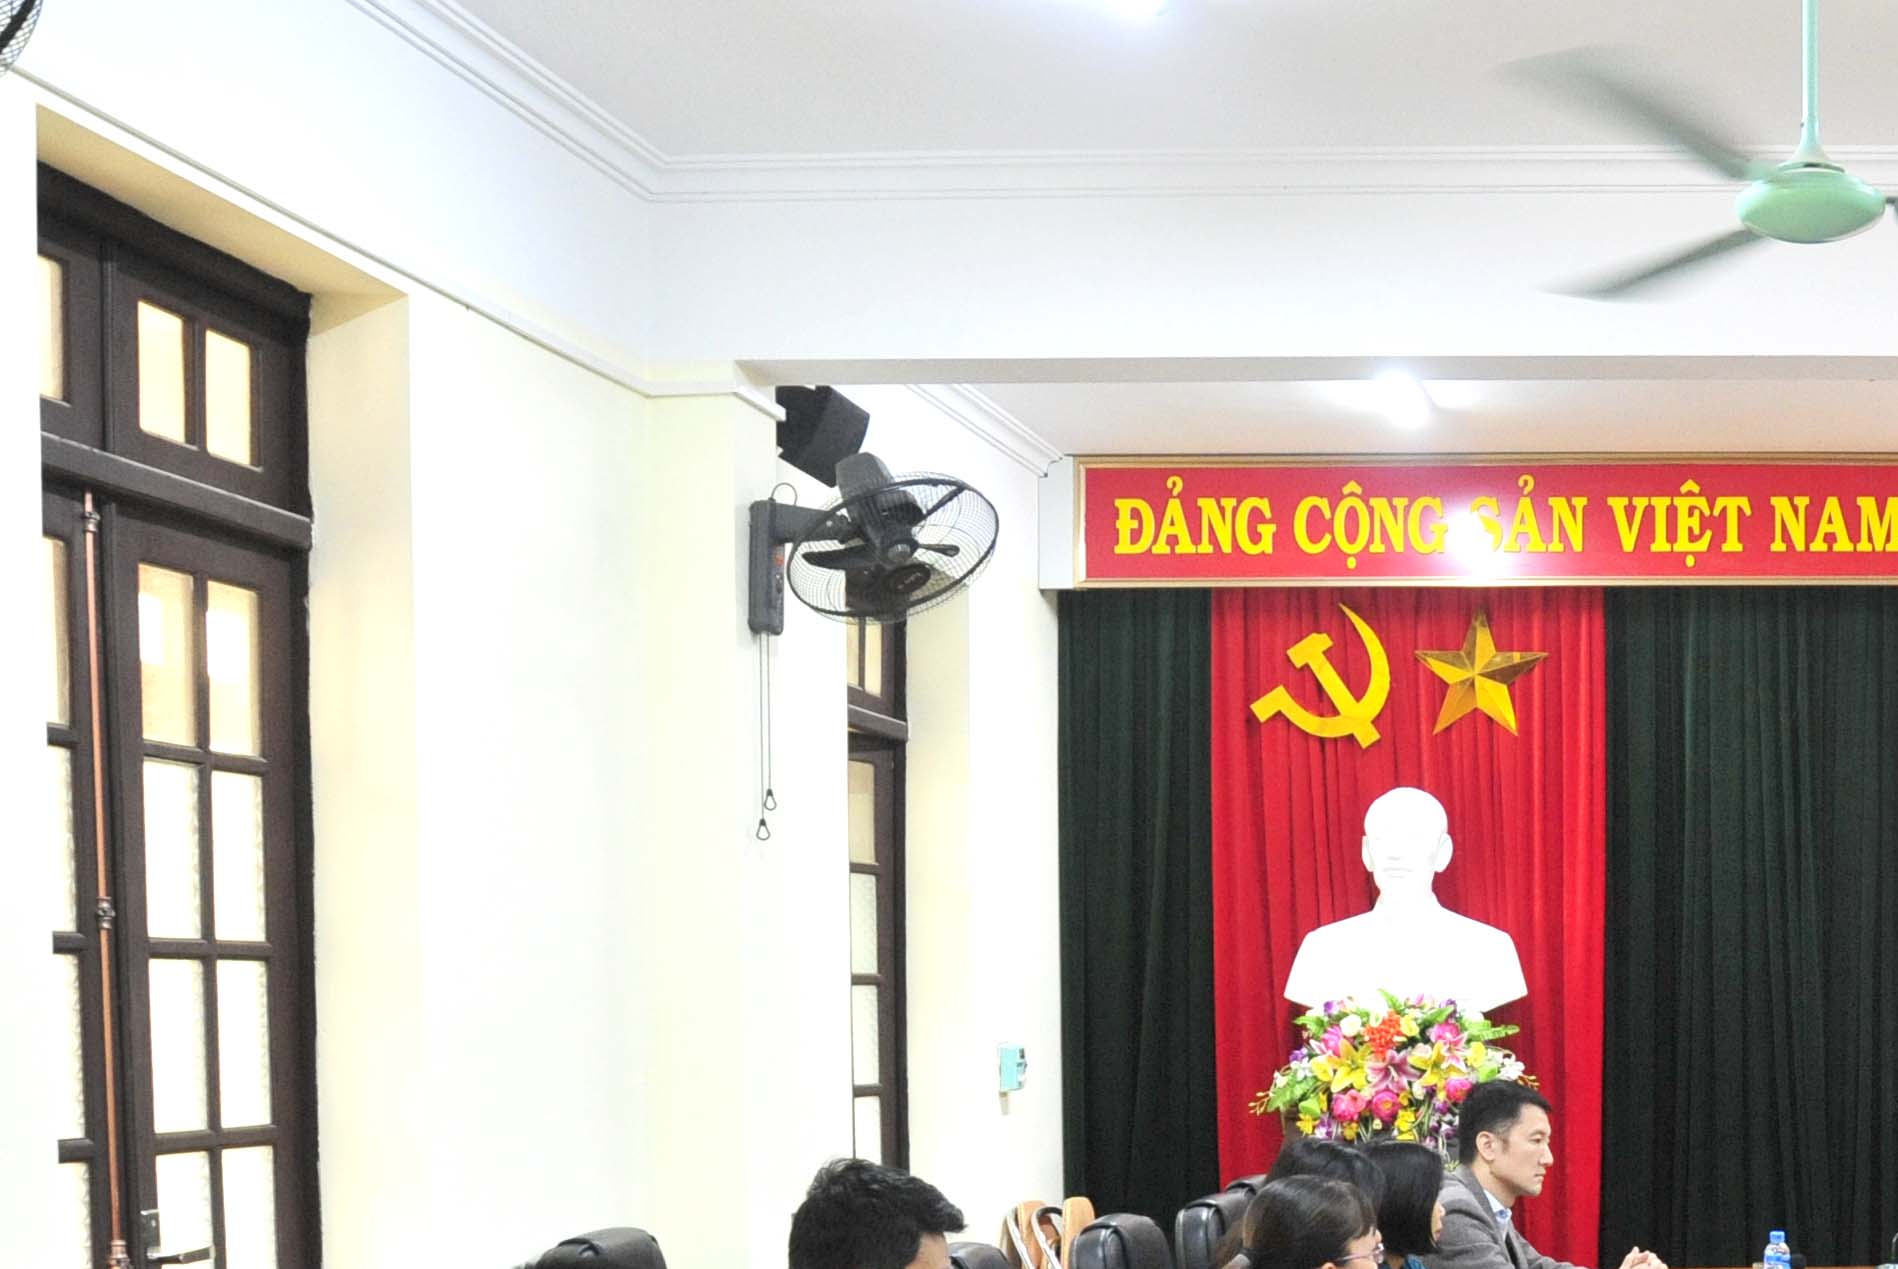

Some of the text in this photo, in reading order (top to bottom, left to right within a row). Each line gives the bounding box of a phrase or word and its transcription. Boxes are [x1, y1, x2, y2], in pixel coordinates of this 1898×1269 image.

[1113, 475, 1277, 556] ĐẢNG
[1293, 480, 1448, 570] CỘNG
[1471, 474, 1588, 553] SẢN
[1606, 479, 1752, 568] VIỆT
